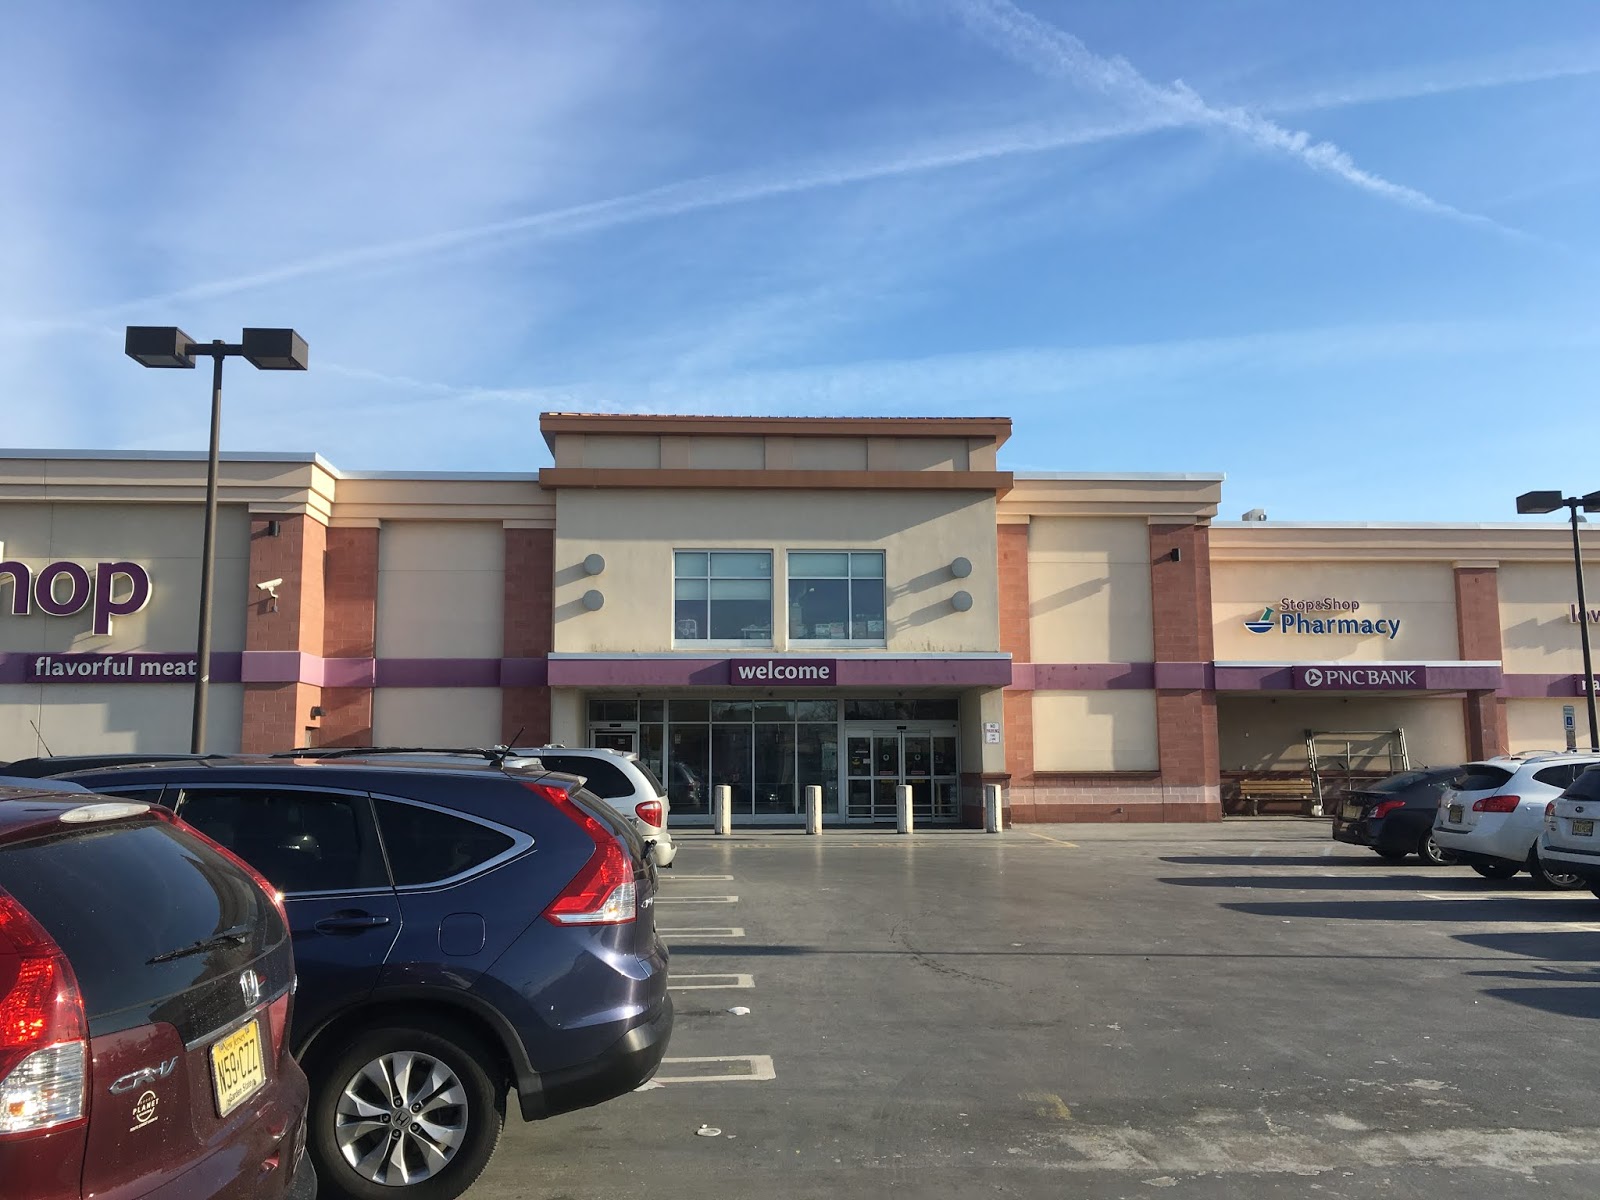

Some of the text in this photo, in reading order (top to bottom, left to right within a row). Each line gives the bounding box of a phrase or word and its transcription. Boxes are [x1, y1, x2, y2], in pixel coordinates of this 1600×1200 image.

[1281, 613, 1401, 639] Pharmacy
[35, 656, 197, 676] flavorful meat
[738, 660, 830, 679] welcome
[132, 1098, 159, 1115] PLANET
